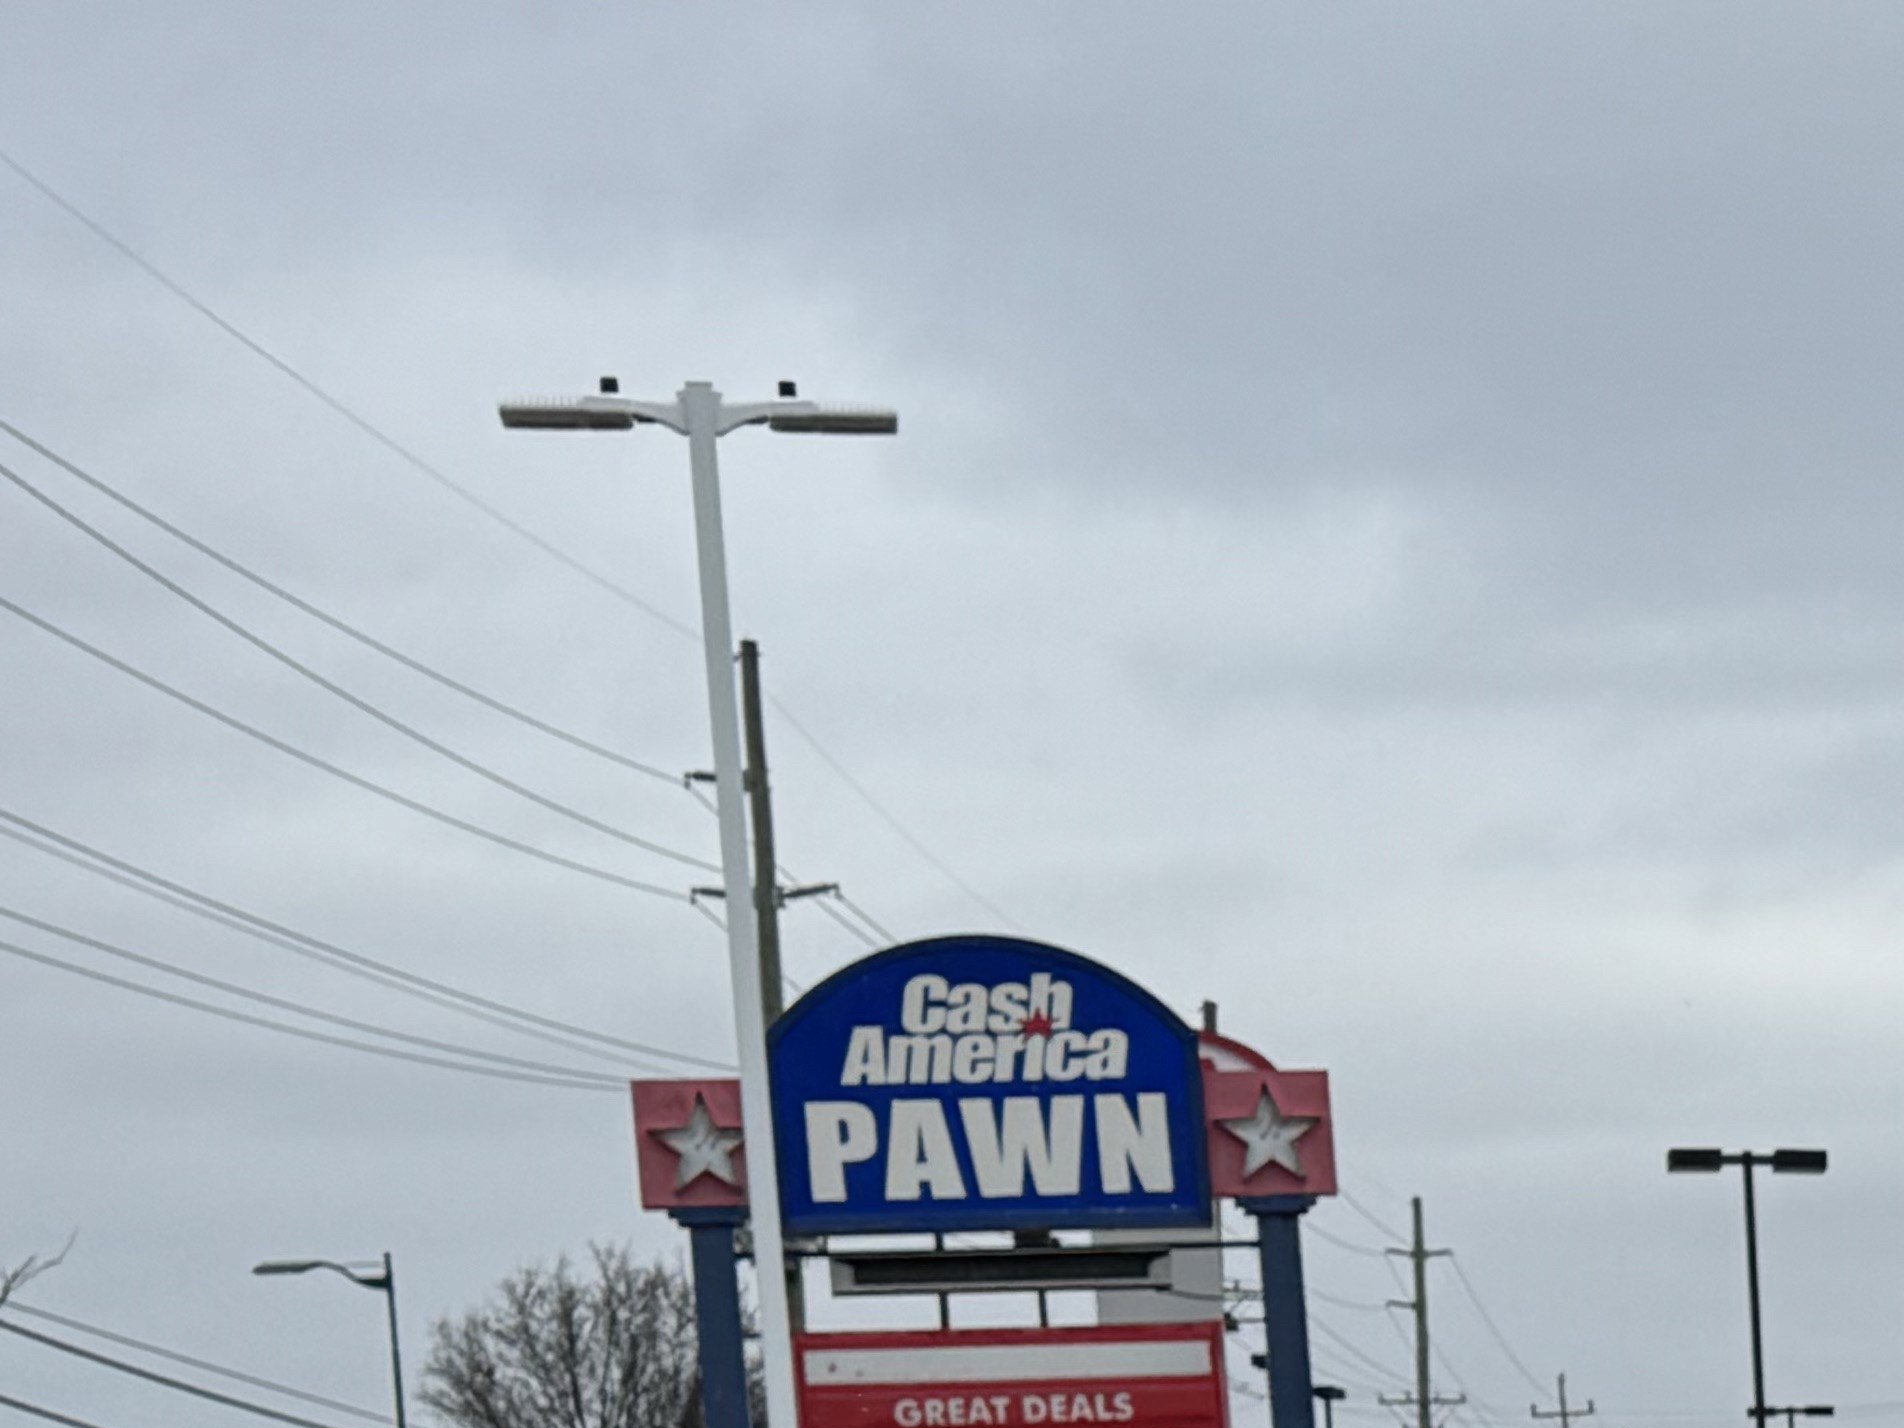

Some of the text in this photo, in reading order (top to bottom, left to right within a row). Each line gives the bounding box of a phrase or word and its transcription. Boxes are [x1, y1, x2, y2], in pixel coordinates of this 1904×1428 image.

[903, 972, 1072, 1036] Cash
[841, 1025, 1129, 1086] America
[804, 1092, 1174, 1203] PAWN
[1022, 1393, 1134, 1423] DEALS
